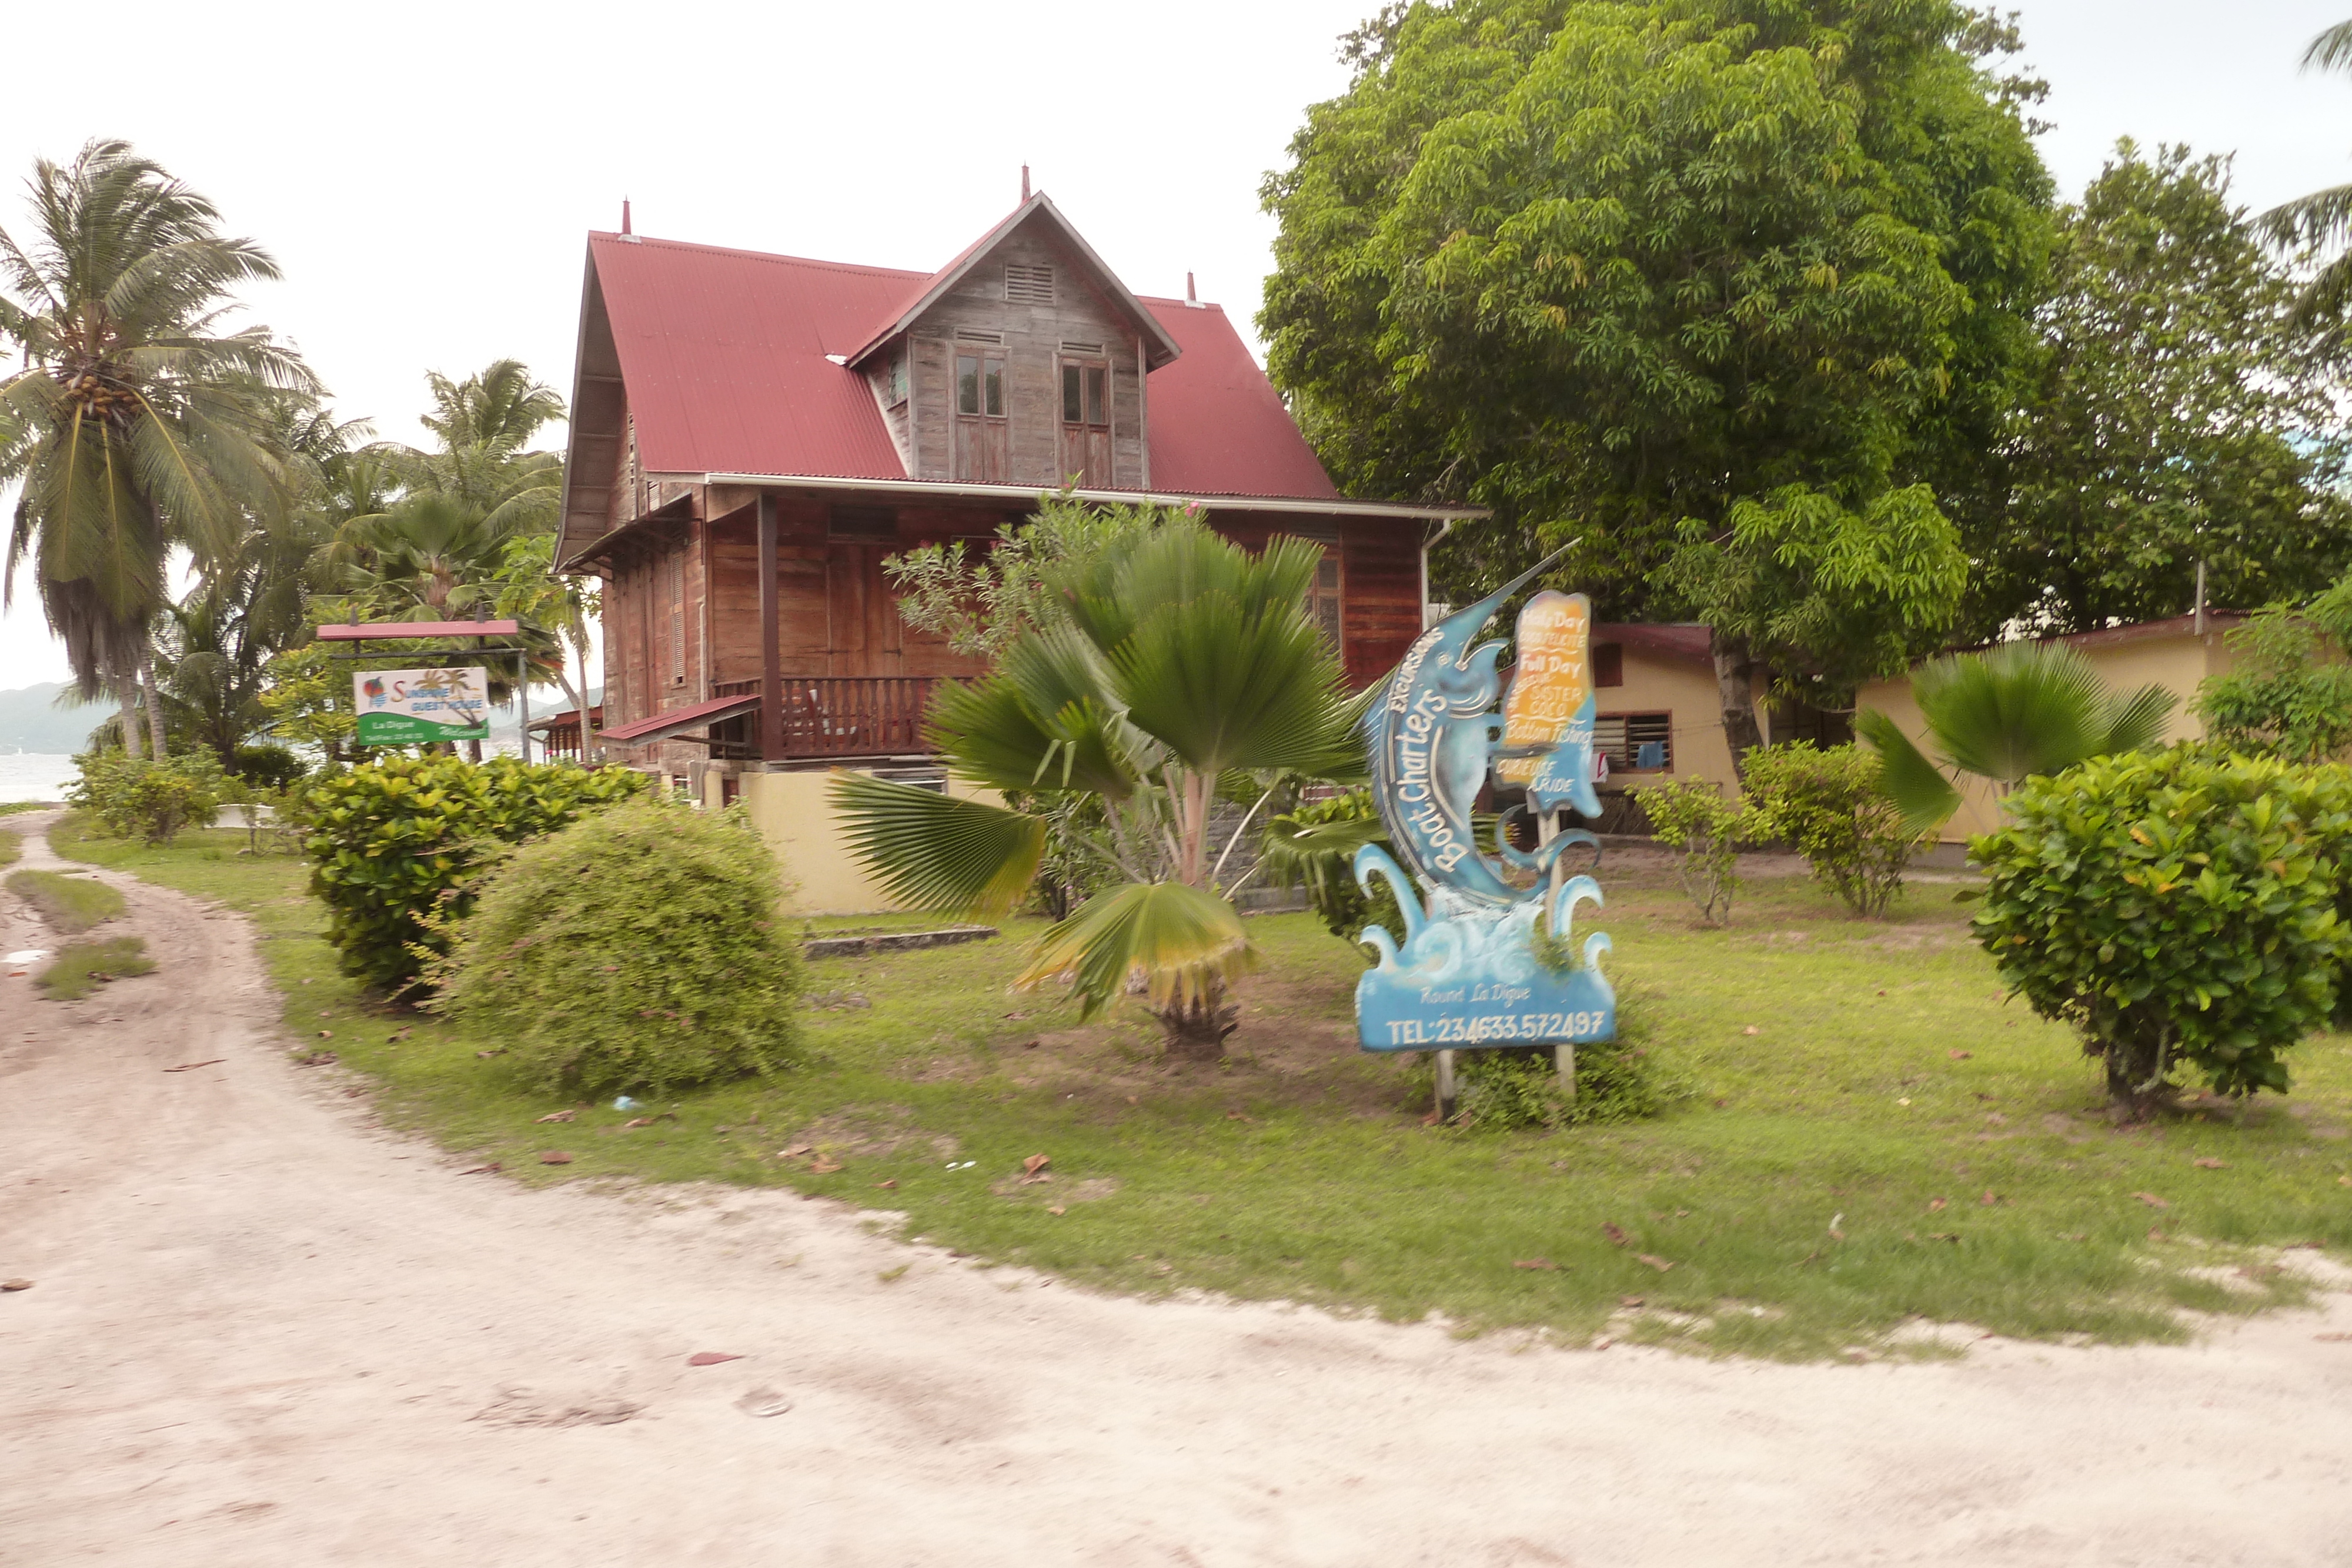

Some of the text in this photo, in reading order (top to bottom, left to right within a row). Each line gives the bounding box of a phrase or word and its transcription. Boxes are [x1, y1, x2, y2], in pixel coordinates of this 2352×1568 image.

[1554, 611, 1586, 633] Day
[1390, 627, 1445, 714] EXCURSIONS
[1520, 654, 1582, 679] Full Day
[1530, 686, 1583, 702] SISTER
[1530, 700, 1567, 716] COCO
[1504, 719, 1594, 751] Bottom Fishing
[1496, 758, 1558, 777] CURIEUSE
[1395, 689, 1469, 872] Boat Charters
[1526, 777, 1575, 793] ARIDE
[1419, 982, 1531, 1008] Round La Digue
